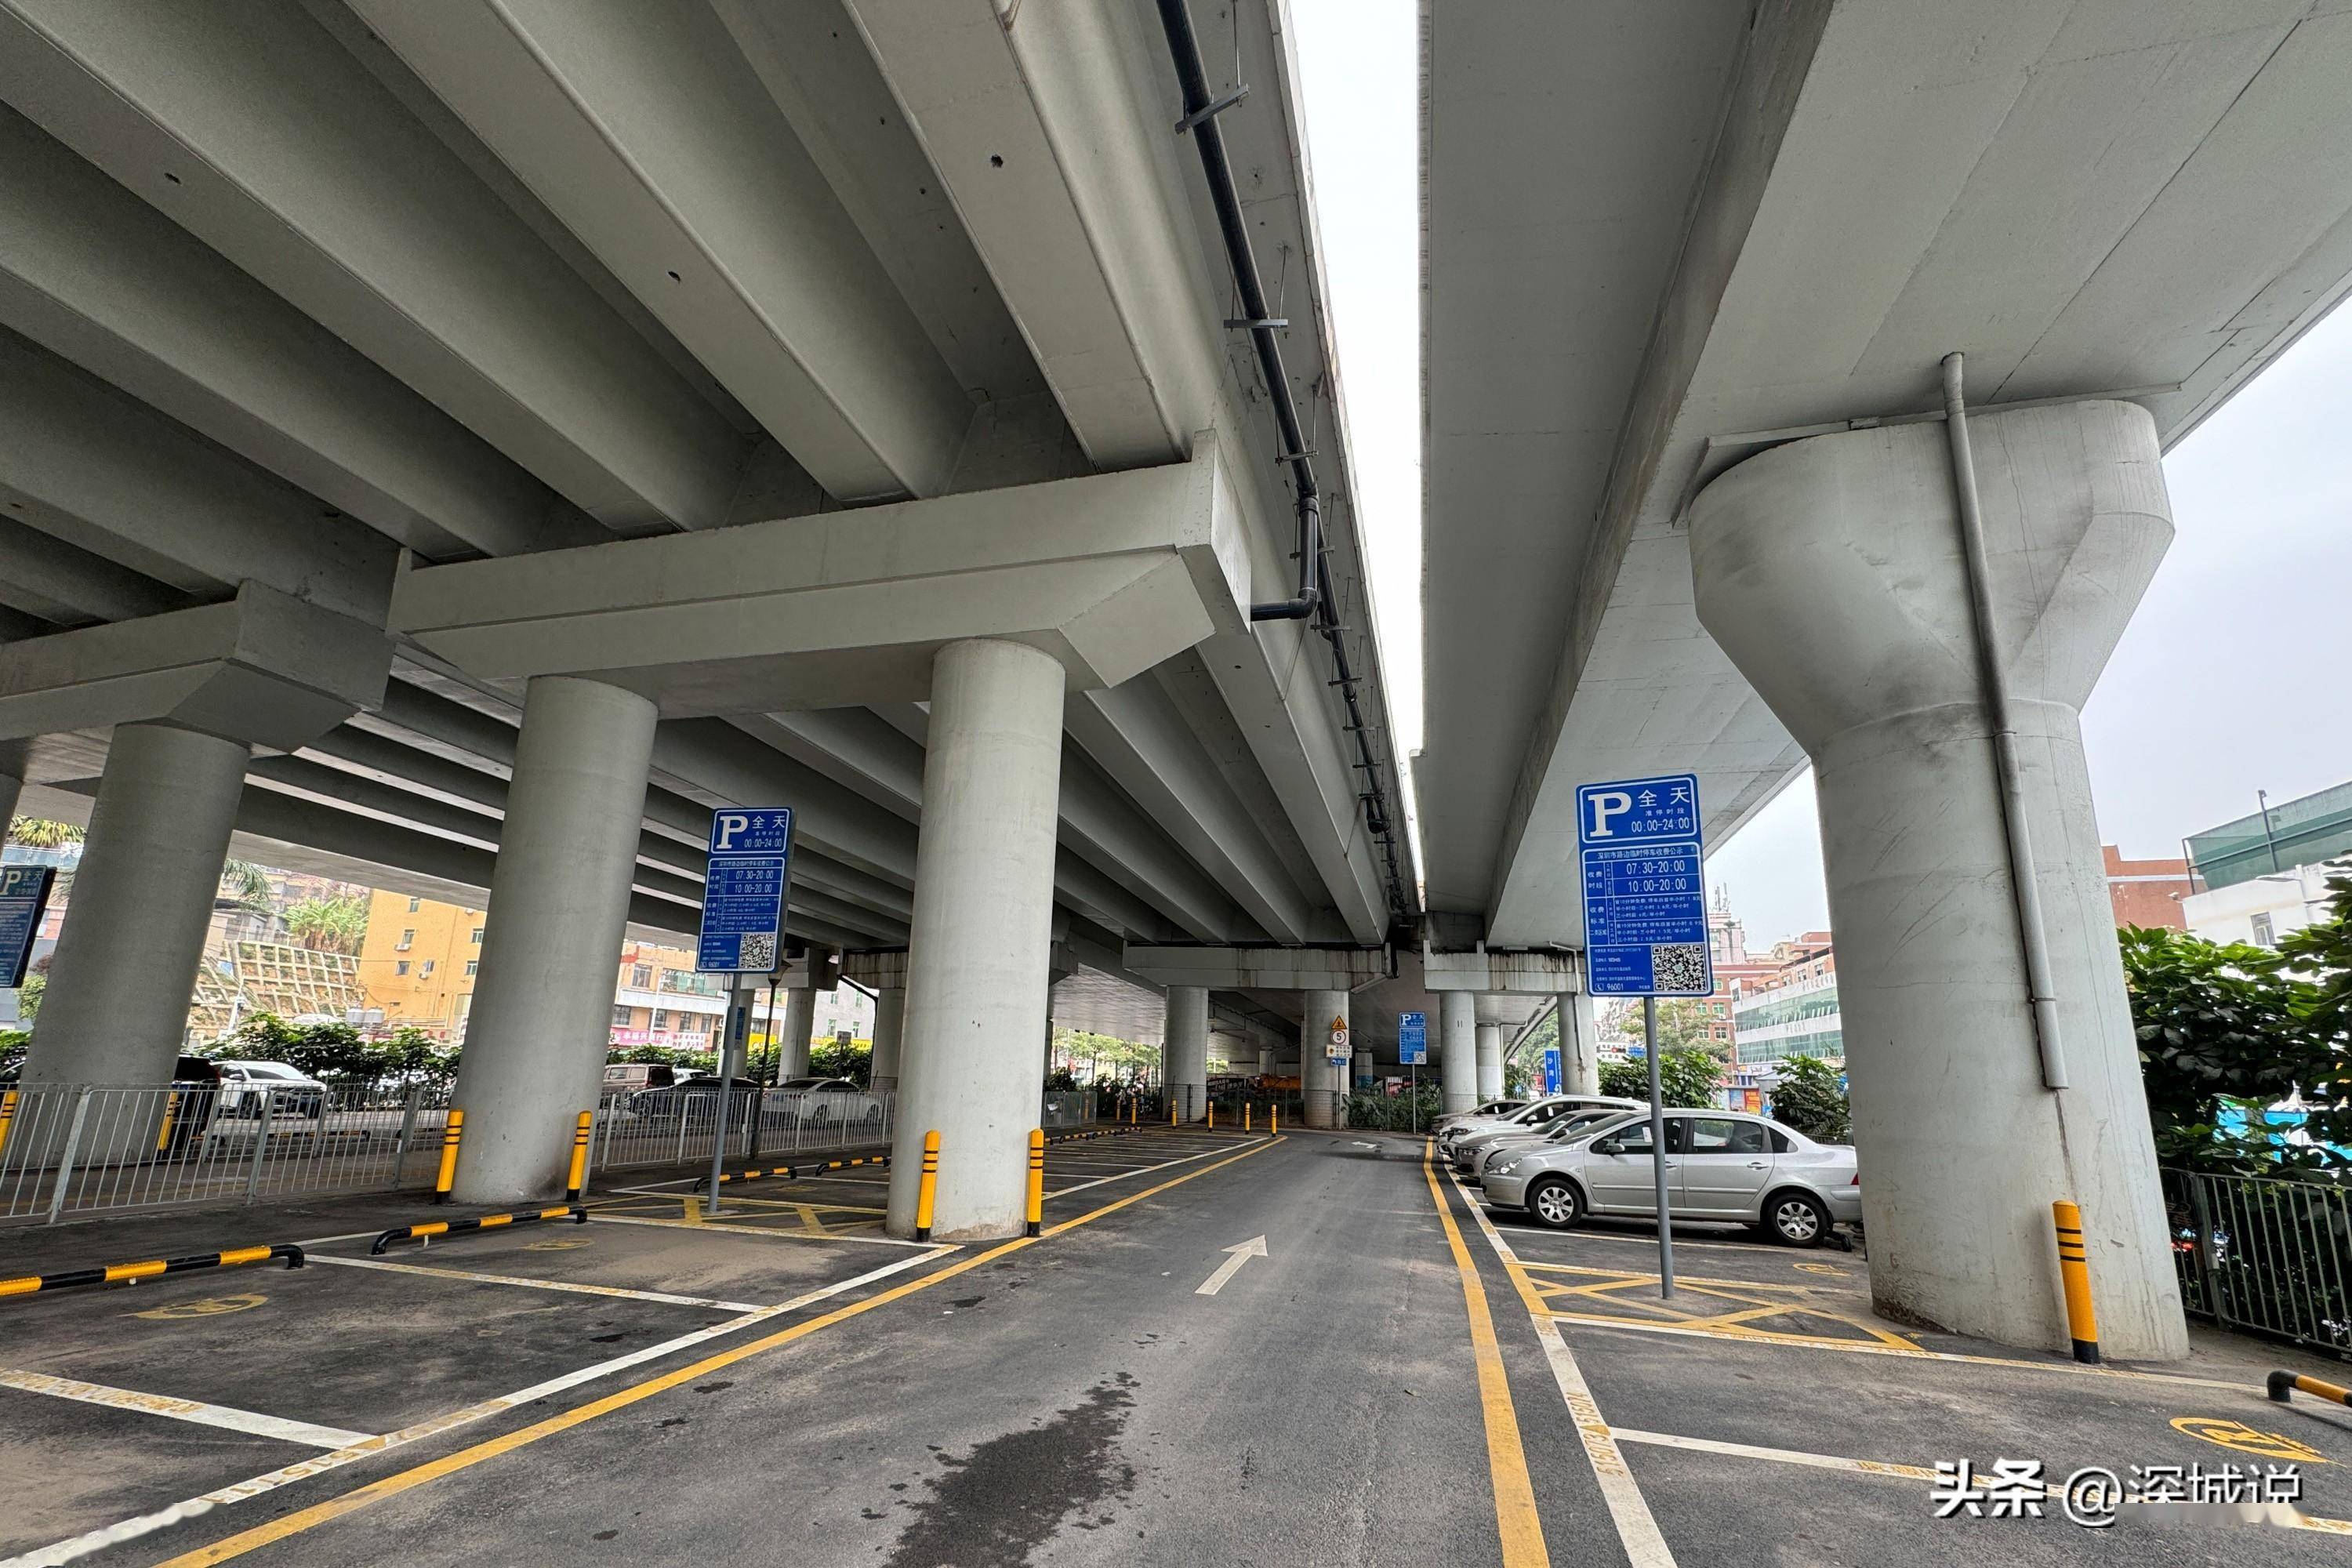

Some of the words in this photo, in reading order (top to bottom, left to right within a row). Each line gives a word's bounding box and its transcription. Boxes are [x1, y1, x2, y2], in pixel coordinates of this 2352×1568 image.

[1638, 786, 1690, 808] 全天
[752, 815, 786, 829] 全天
[1588, 792, 1632, 837] P
[716, 815, 748, 849] P
[1631, 816, 1690, 833] 00:00-24:00
[744, 837, 782, 848] 00:00-24:00
[1626, 859, 1685, 875] 07:30-20:00
[0, 870, 22, 895] P
[1628, 878, 1686, 893] 10:00-20:00
[1401, 1014, 1411, 1025] P
[1336, 1033, 1341, 1041] 5
